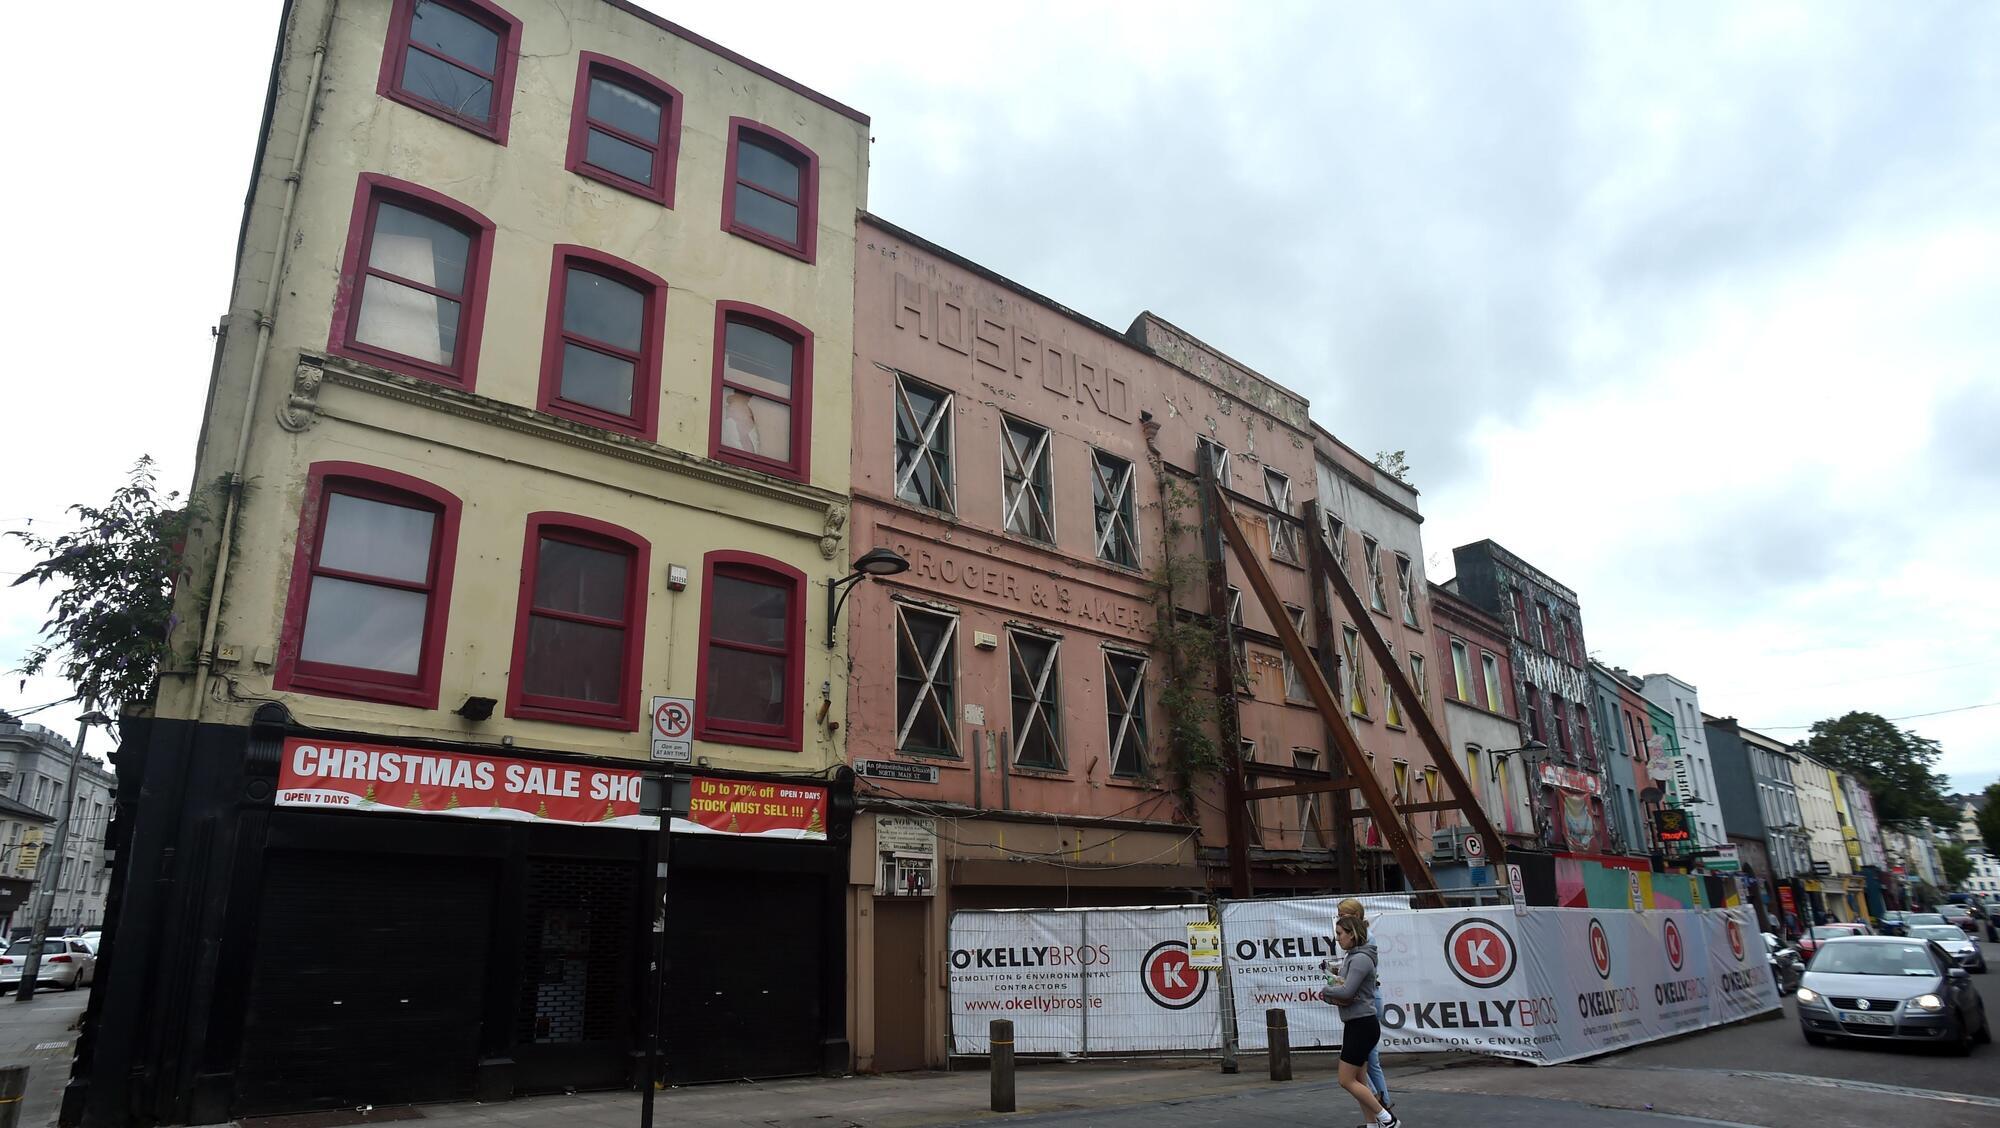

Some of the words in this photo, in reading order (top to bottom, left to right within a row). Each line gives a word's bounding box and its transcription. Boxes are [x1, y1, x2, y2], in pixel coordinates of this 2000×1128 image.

[894, 271, 1133, 425] HOSFORD
[1031, 584, 1048, 608] &
[293, 745, 495, 791] CHRISTMAS
[504, 764, 581, 798] SALE
[878, 769, 895, 777] NORTH
[284, 791, 311, 803] OPEN
[315, 794, 321, 803] 7
[324, 794, 350, 805] DAYS
[701, 781, 716, 796] Up
[719, 783, 730, 795] to
[733, 784, 757, 797] 70%
[759, 786, 774, 799] off
[780, 789, 797, 799] OPEN
[799, 791, 803, 799] 7
[804, 791, 821, 800] DAYS
[691, 798, 727, 813] STOCK
[730, 801, 761, 815] MUST
[763, 805, 788, 817] SELL
[951, 944, 1110, 969] O'KELLYBROS
[1468, 939, 1496, 966] K
[951, 974, 1012, 982] DEMOLITION
[1026, 972, 1111, 980] ENVIRONMENTAL
[1163, 962, 1188, 988] K
[1238, 964, 1303, 975] DEMOLITION
[994, 983, 1068, 991] CONTRACTORS
[964, 995, 1103, 1012] www.okellybros.ie
[1380, 996, 1558, 1030] O'KELLYBROS
[1383, 1036, 1470, 1047] DEMOLITION
[1474, 1037, 1483, 1045] &
